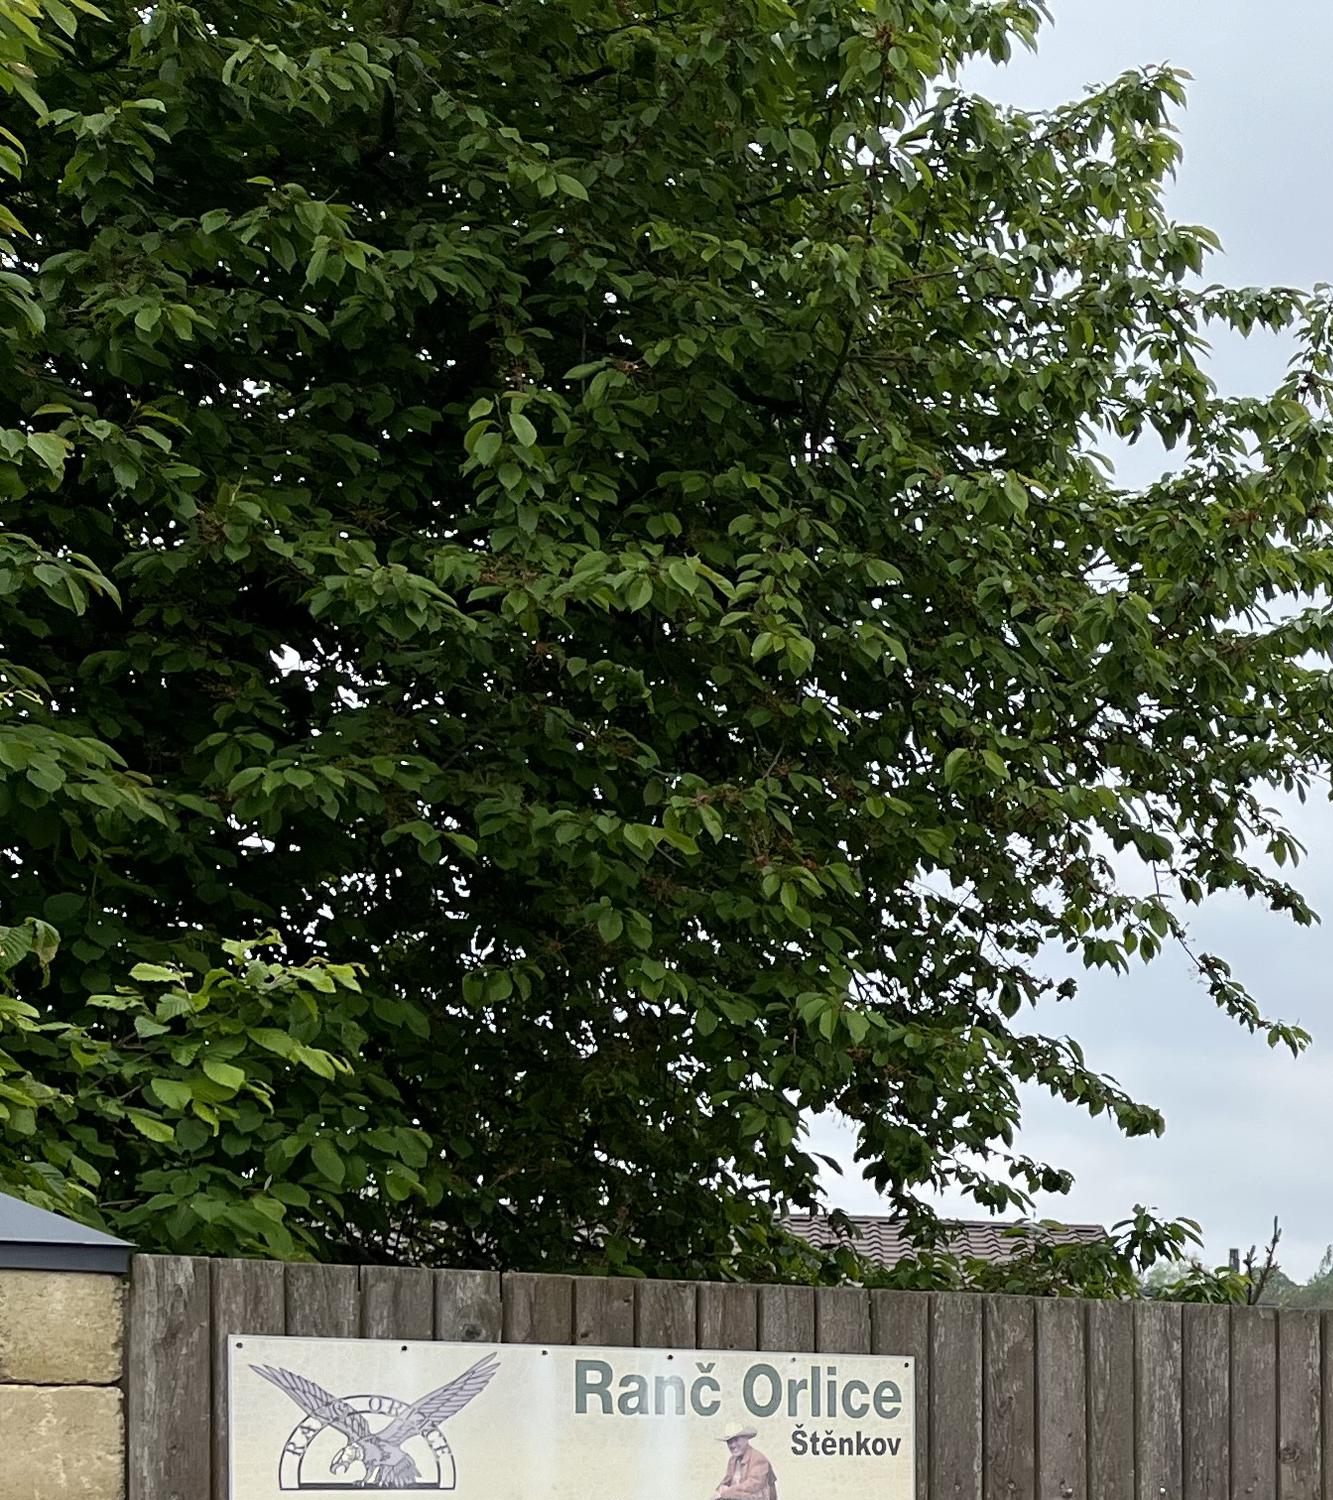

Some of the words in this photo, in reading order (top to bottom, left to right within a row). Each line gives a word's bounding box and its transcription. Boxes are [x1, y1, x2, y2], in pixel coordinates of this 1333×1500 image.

[574, 1359, 721, 1417] Ranč
[742, 1363, 903, 1419] Orlice
[790, 1423, 902, 1457] Štěnkov
